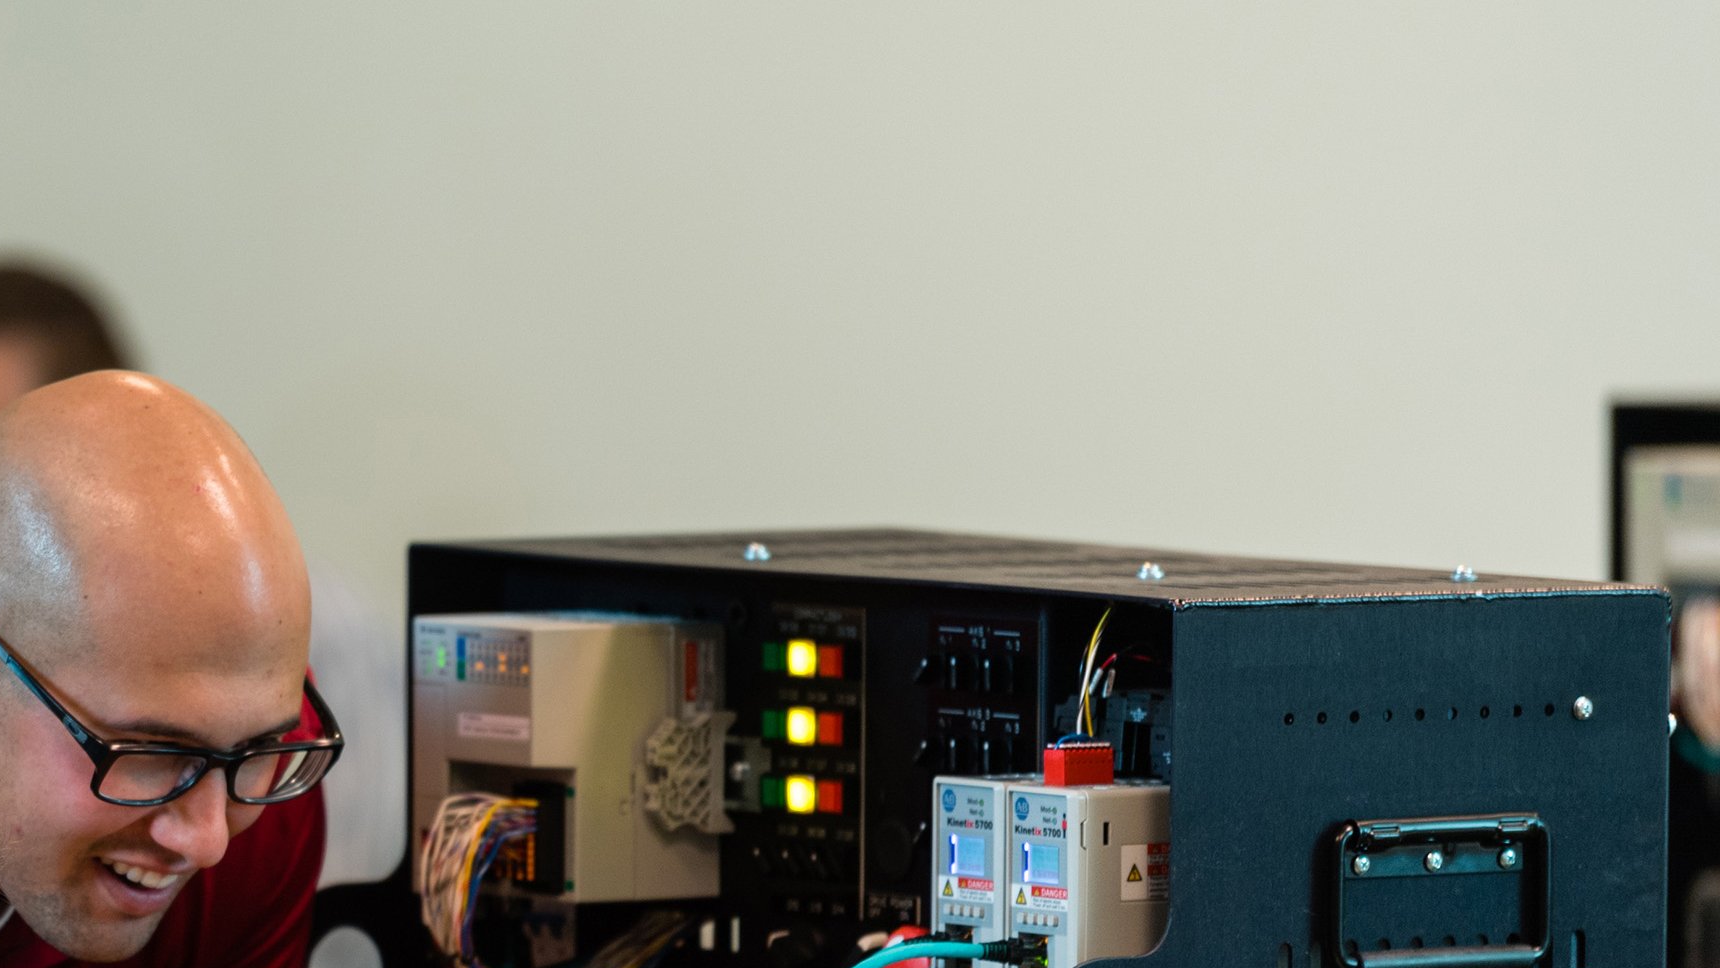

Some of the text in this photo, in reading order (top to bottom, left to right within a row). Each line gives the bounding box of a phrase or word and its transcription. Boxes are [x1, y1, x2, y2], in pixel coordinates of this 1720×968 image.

[947, 817, 994, 831] Kinetix 5700
[1015, 825, 1062, 839] Kinetix 5700
[967, 880, 994, 890] DANGER
[1041, 888, 1067, 899] DANGER
